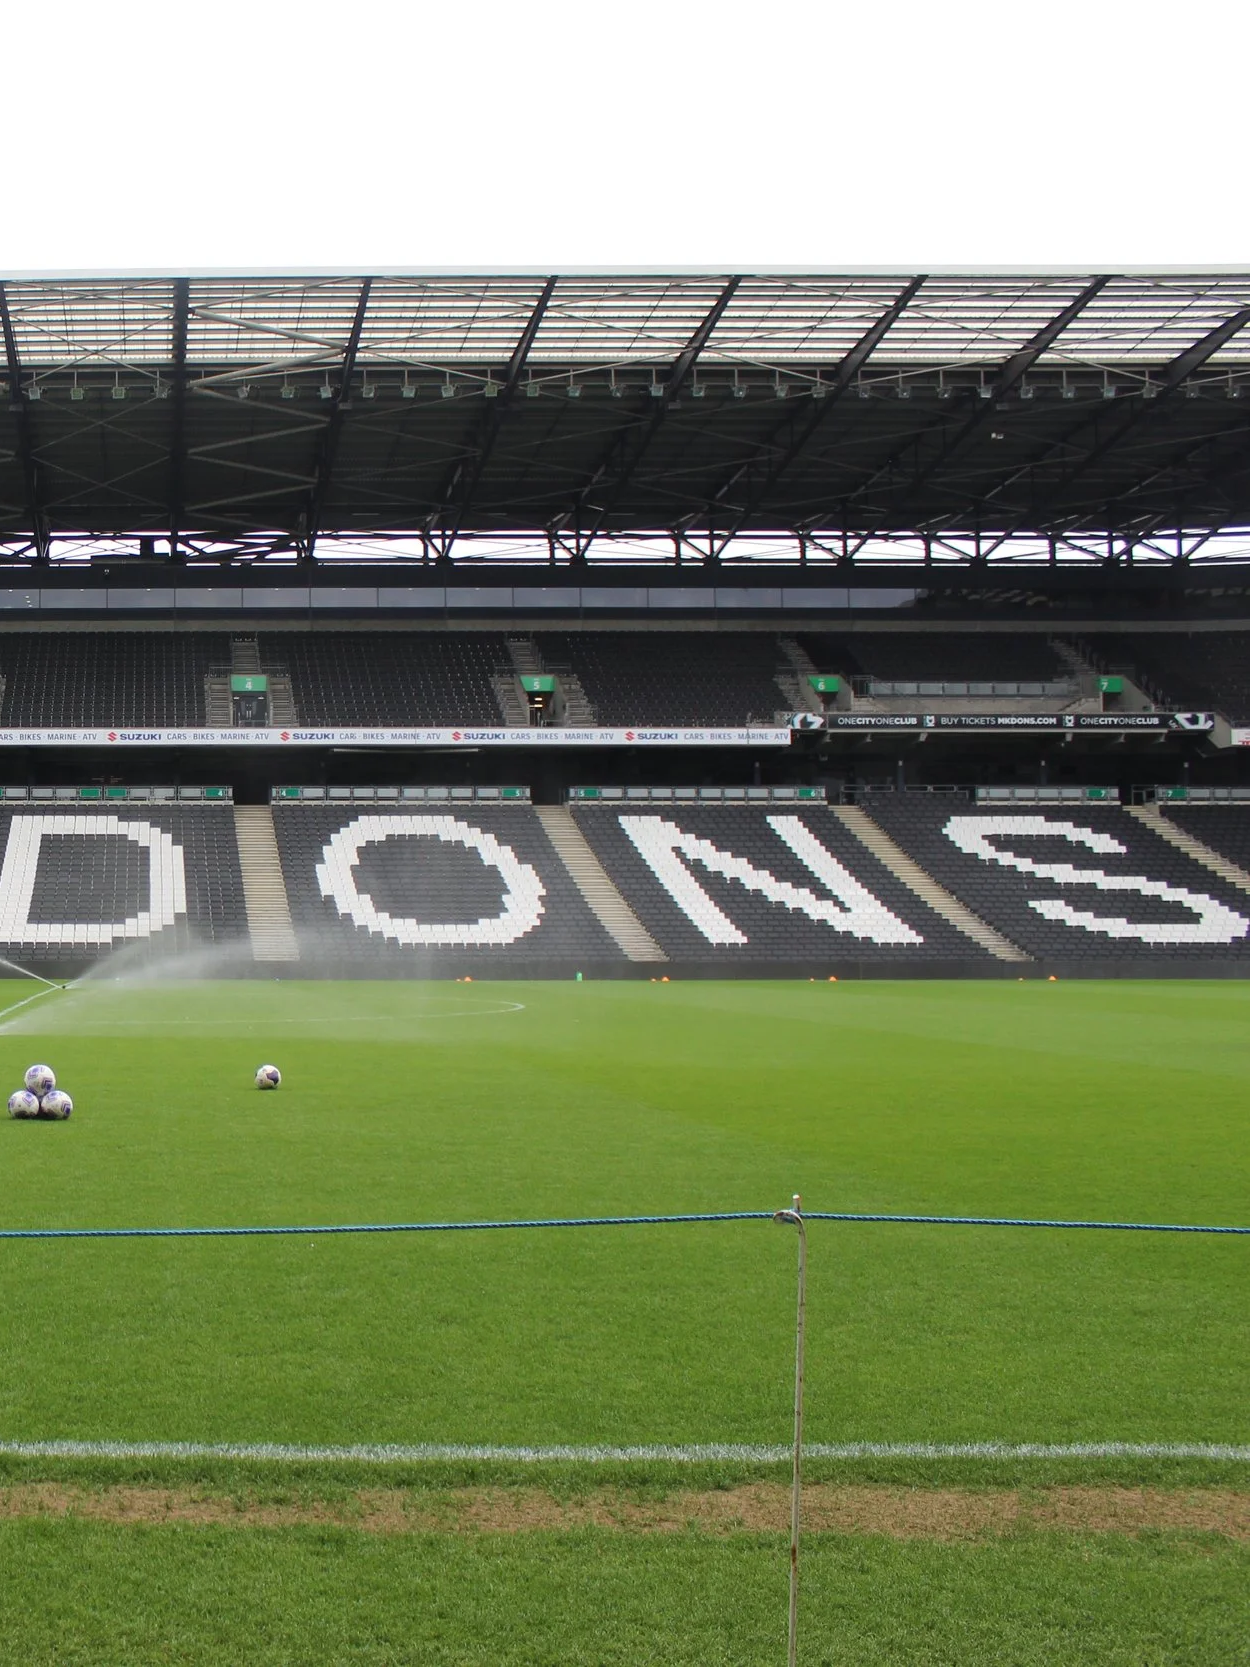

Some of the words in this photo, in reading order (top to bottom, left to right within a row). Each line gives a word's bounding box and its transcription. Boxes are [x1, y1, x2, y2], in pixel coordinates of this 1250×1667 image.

[245, 681, 253, 690] 4
[533, 681, 540, 690] 5
[818, 682, 826, 690] 6
[1101, 682, 1108, 690] 7
[837, 717, 918, 725] ONECITYONECLUB
[941, 717, 958, 725] BUY
[962, 717, 996, 725] TICKETS
[998, 717, 1057, 725] MKDONS.COM
[1080, 717, 1160, 725] ONECITYONECLUB
[19, 733, 41, 741] BIKES
[47, 733, 76, 741] MARINE
[83, 733, 97, 741] ATV
[120, 733, 161, 741] SUZUKI
[167, 733, 187, 741] CARS
[193, 733, 215, 741] BIKES
[220, 733, 249, 741] MARINE
[254, 733, 269, 741] ATV
[292, 733, 334, 741] SUZUKI
[363, 733, 384, 741] BIKES
[391, 733, 420, 741] MARINE
[426, 733, 440, 741] ATV
[464, 733, 505, 741] SUZUKI
[511, 733, 530, 741] CARS
[537, 733, 558, 741] BIKES
[565, 733, 593, 741] MARINE
[599, 733, 613, 741] ATV
[637, 733, 678, 741] SUZUKI
[684, 733, 704, 741] CARS
[710, 733, 732, 741] BIKES
[738, 733, 768, 741] MARINE
[774, 733, 788, 741] ATV
